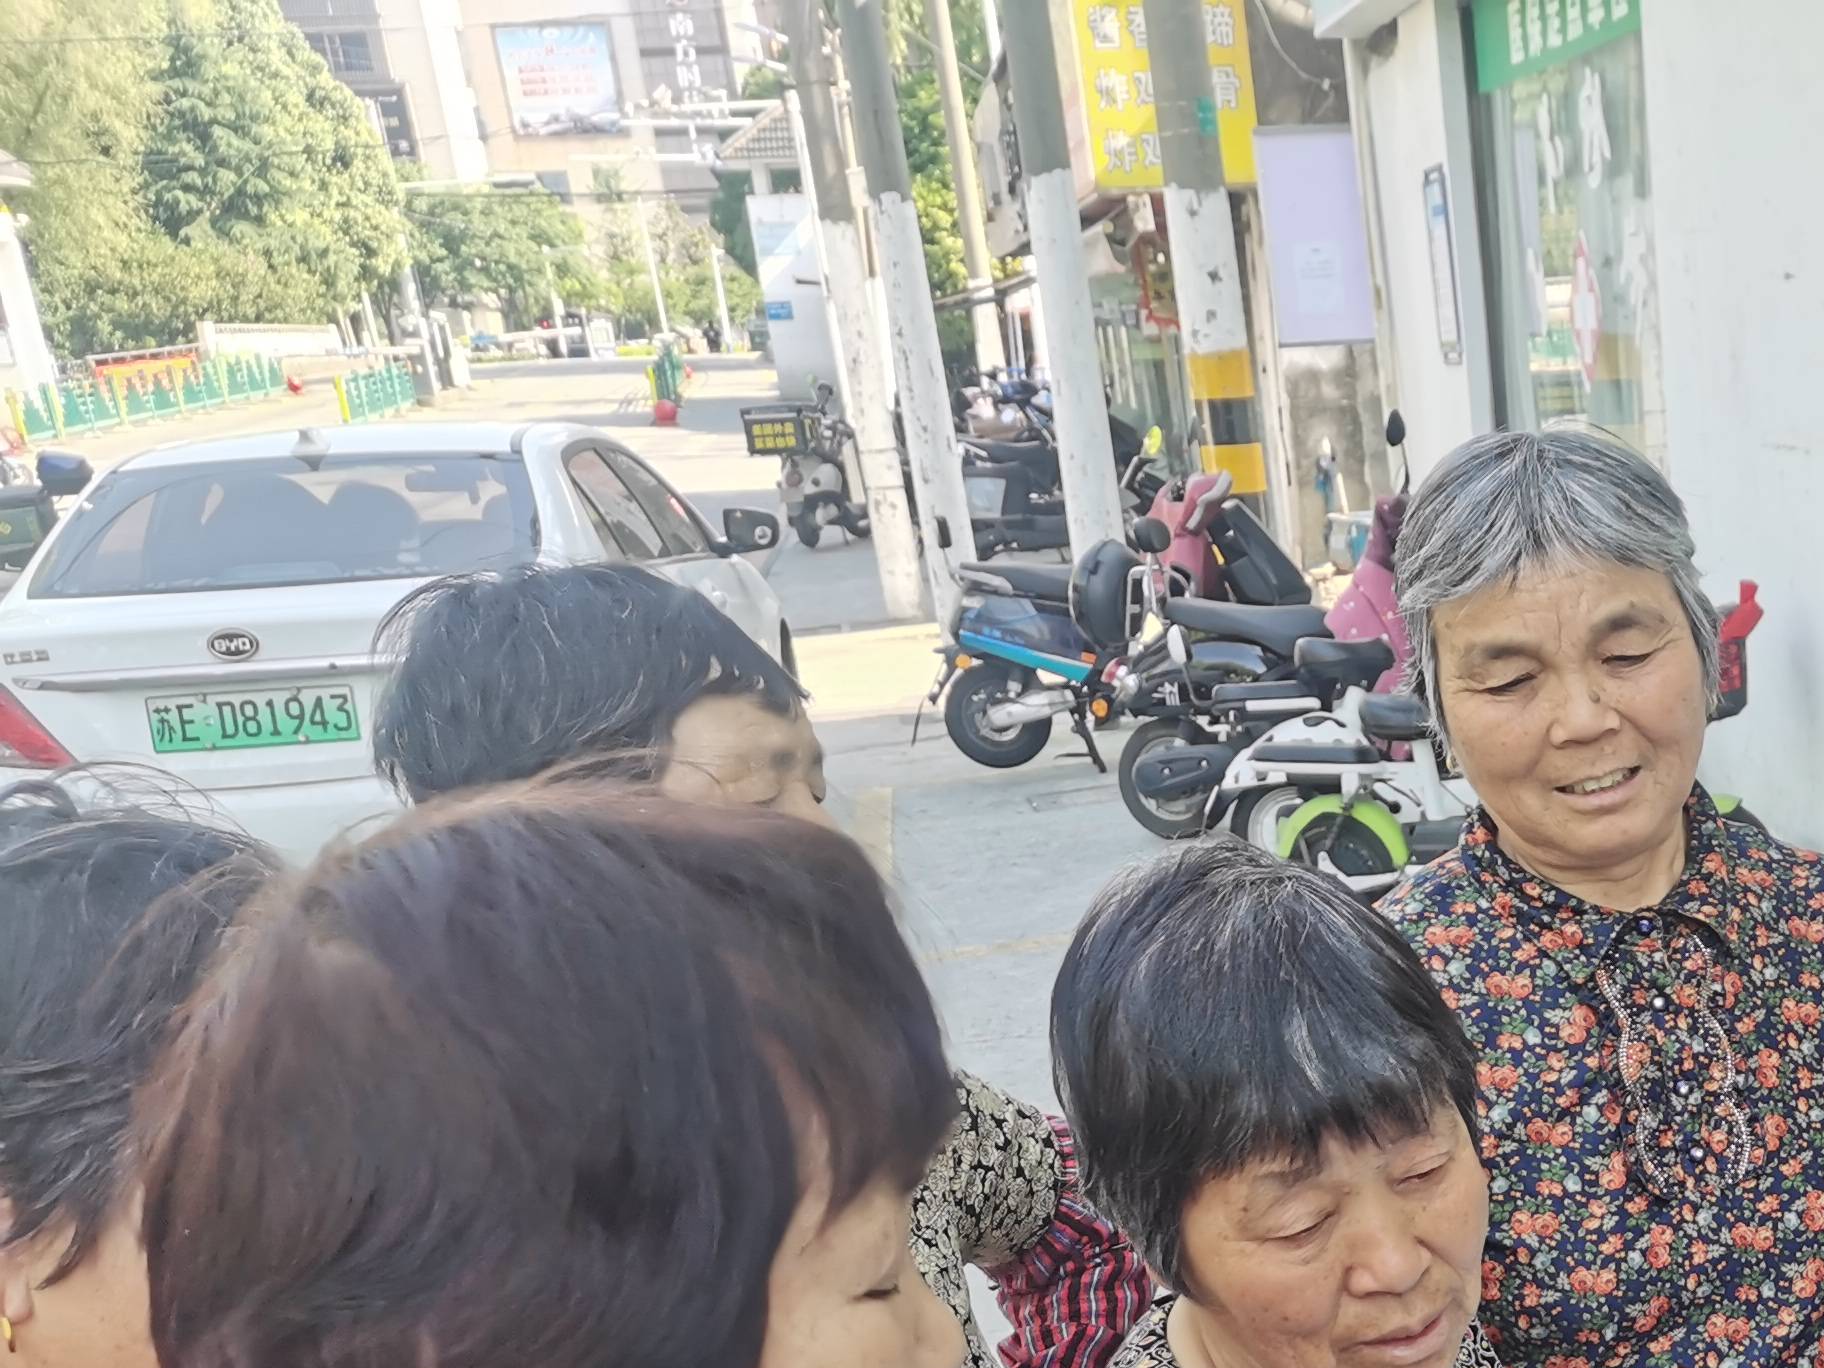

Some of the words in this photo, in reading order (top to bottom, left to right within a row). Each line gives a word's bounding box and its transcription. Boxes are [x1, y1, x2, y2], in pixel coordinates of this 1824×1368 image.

[1088, 4, 1234, 48] 酱香蹄
[1095, 66, 1241, 111] 炸骨
[214, 637, 251, 653] BYD
